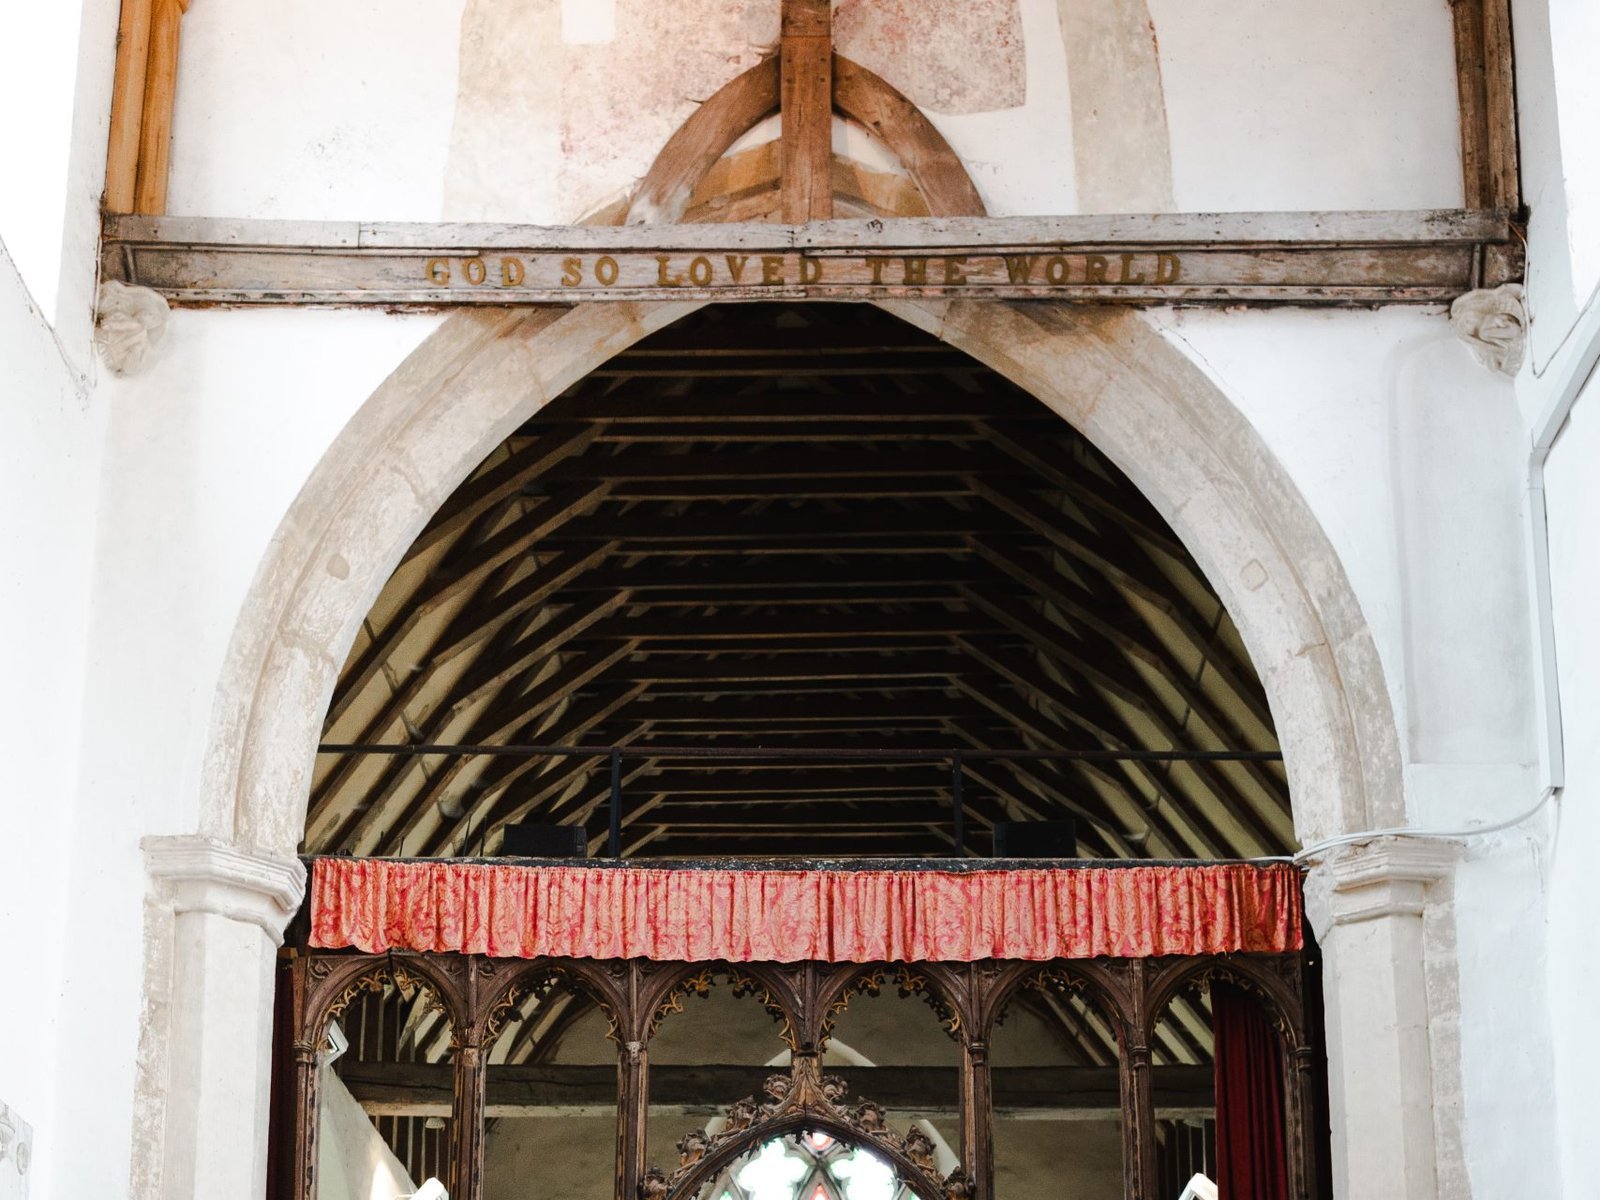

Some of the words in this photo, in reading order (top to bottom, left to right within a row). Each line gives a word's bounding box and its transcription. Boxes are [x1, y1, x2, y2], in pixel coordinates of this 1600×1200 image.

[425, 256, 525, 287] GOD
[561, 255, 619, 287] SO
[655, 255, 823, 286] LOVED
[865, 255, 967, 285] THE
[1002, 252, 1181, 285] WORLD
